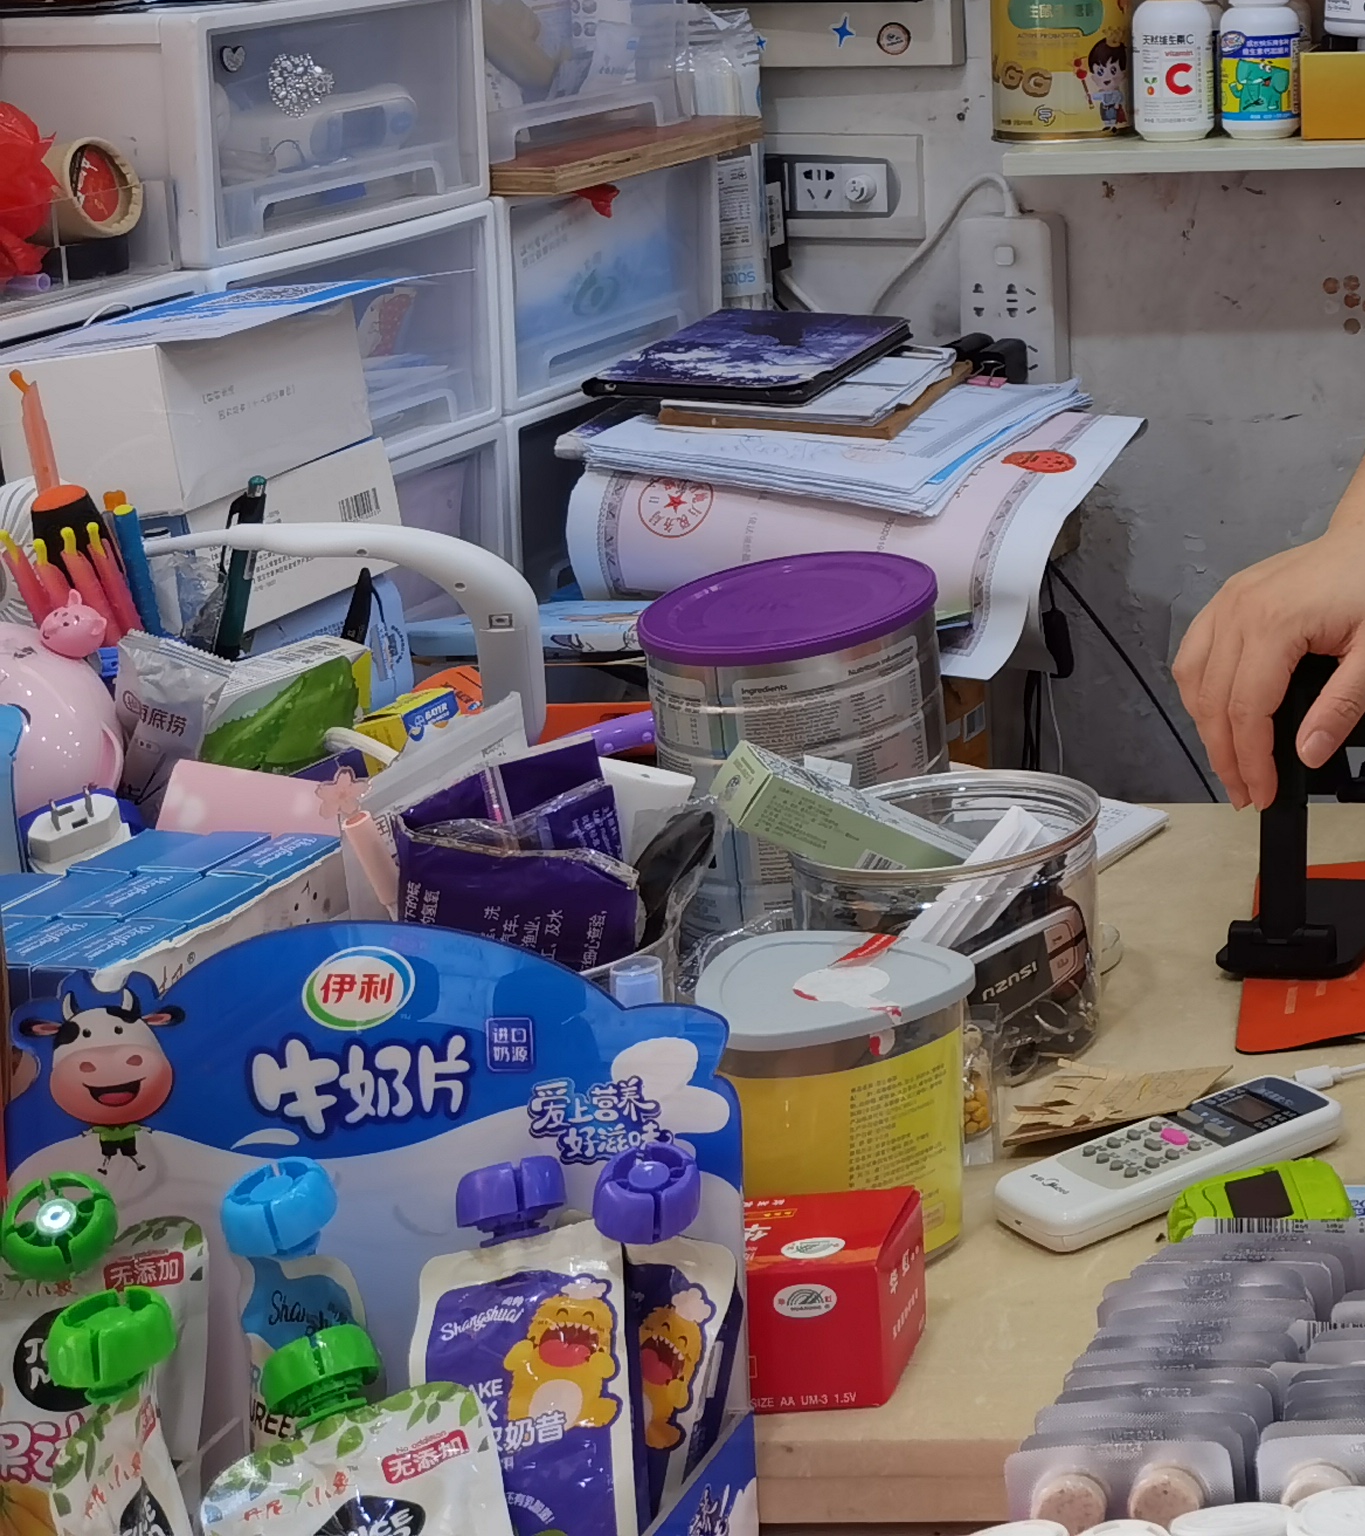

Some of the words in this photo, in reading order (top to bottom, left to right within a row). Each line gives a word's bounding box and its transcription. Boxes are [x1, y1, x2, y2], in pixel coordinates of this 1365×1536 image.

[740, 682, 788, 696] Ingredients
[320, 971, 395, 1005] 伊利
[252, 1037, 471, 1132] 牛奶片
[110, 1255, 182, 1286] 无添加
[779, 1395, 796, 1407] AA
[800, 1393, 829, 1406] UM-3
[832, 1391, 858, 1404] 1.5V
[386, 1437, 465, 1481] 无添加
